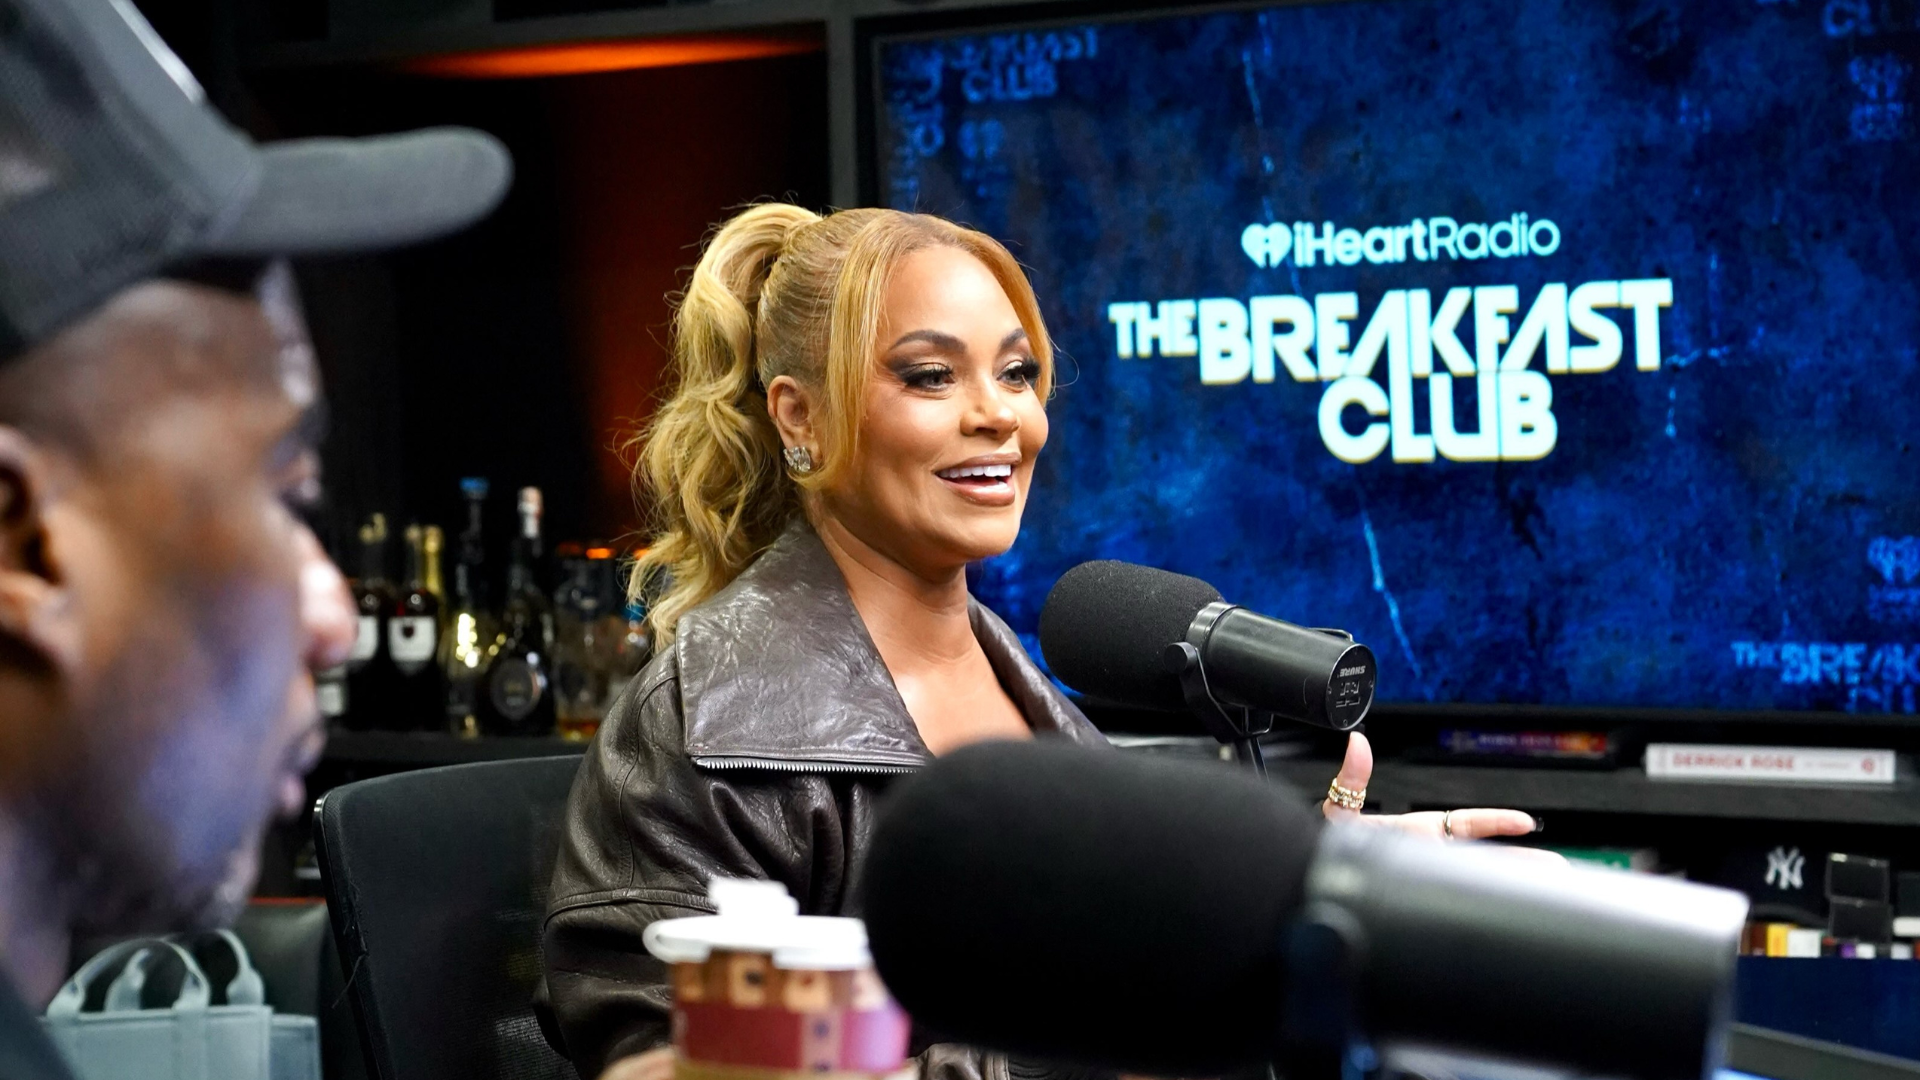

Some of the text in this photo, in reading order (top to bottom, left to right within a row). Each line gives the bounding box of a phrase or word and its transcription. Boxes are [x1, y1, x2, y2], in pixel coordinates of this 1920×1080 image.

[1294, 213, 1560, 266] iHeartRadio
[1108, 279, 1673, 384] THE BREAKFAST
[1318, 371, 1557, 463] CLUB
[1339, 665, 1366, 677] SHURE
[1731, 642, 1779, 668] THE
[1751, 755, 1794, 770] ROSE
[1766, 846, 1805, 889] NY
